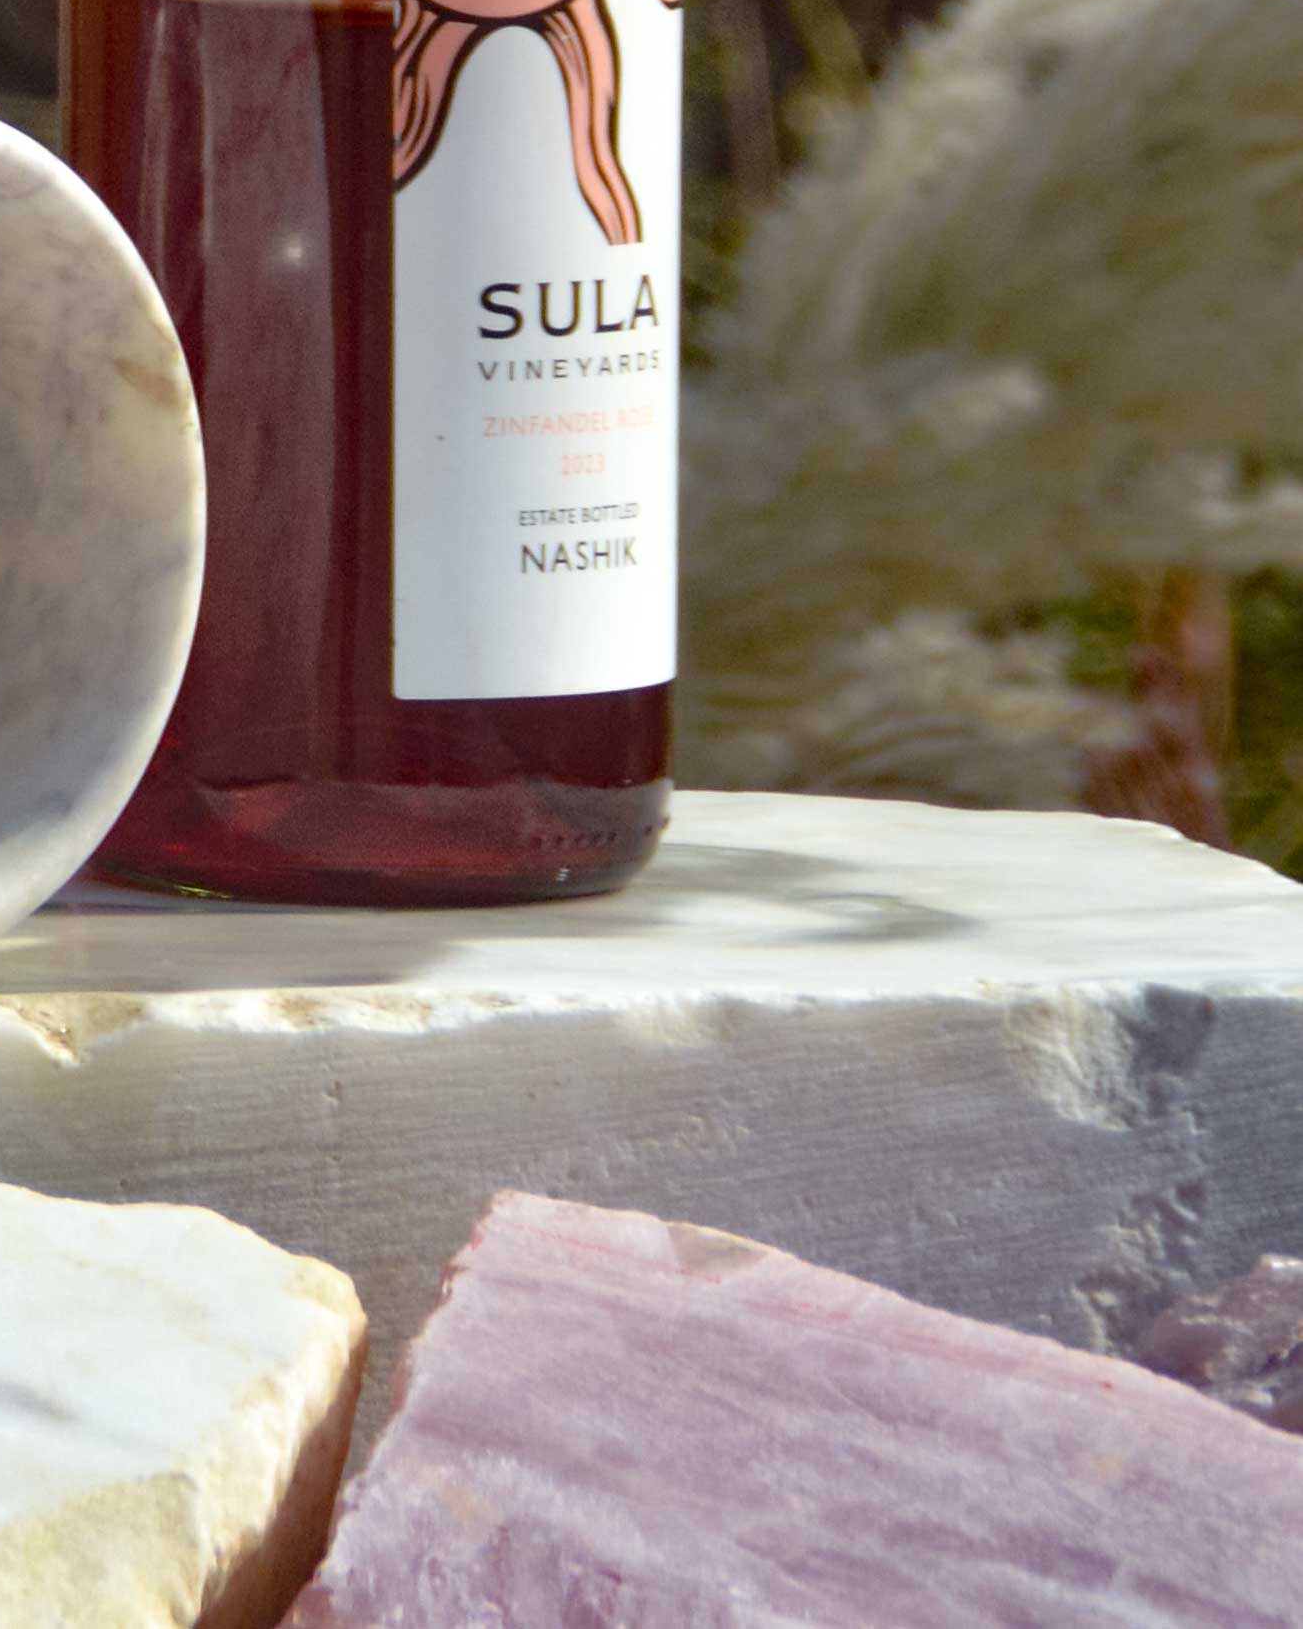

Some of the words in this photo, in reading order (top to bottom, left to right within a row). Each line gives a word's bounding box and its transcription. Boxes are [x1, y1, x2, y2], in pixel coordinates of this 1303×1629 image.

[477, 274, 659, 340] SULA
[477, 349, 661, 382] VINEYARDS
[482, 411, 610, 438] ZINFANDEL
[518, 507, 576, 526] ESTATE
[580, 502, 640, 524] BOTTLED
[520, 537, 638, 574] NASHIK
